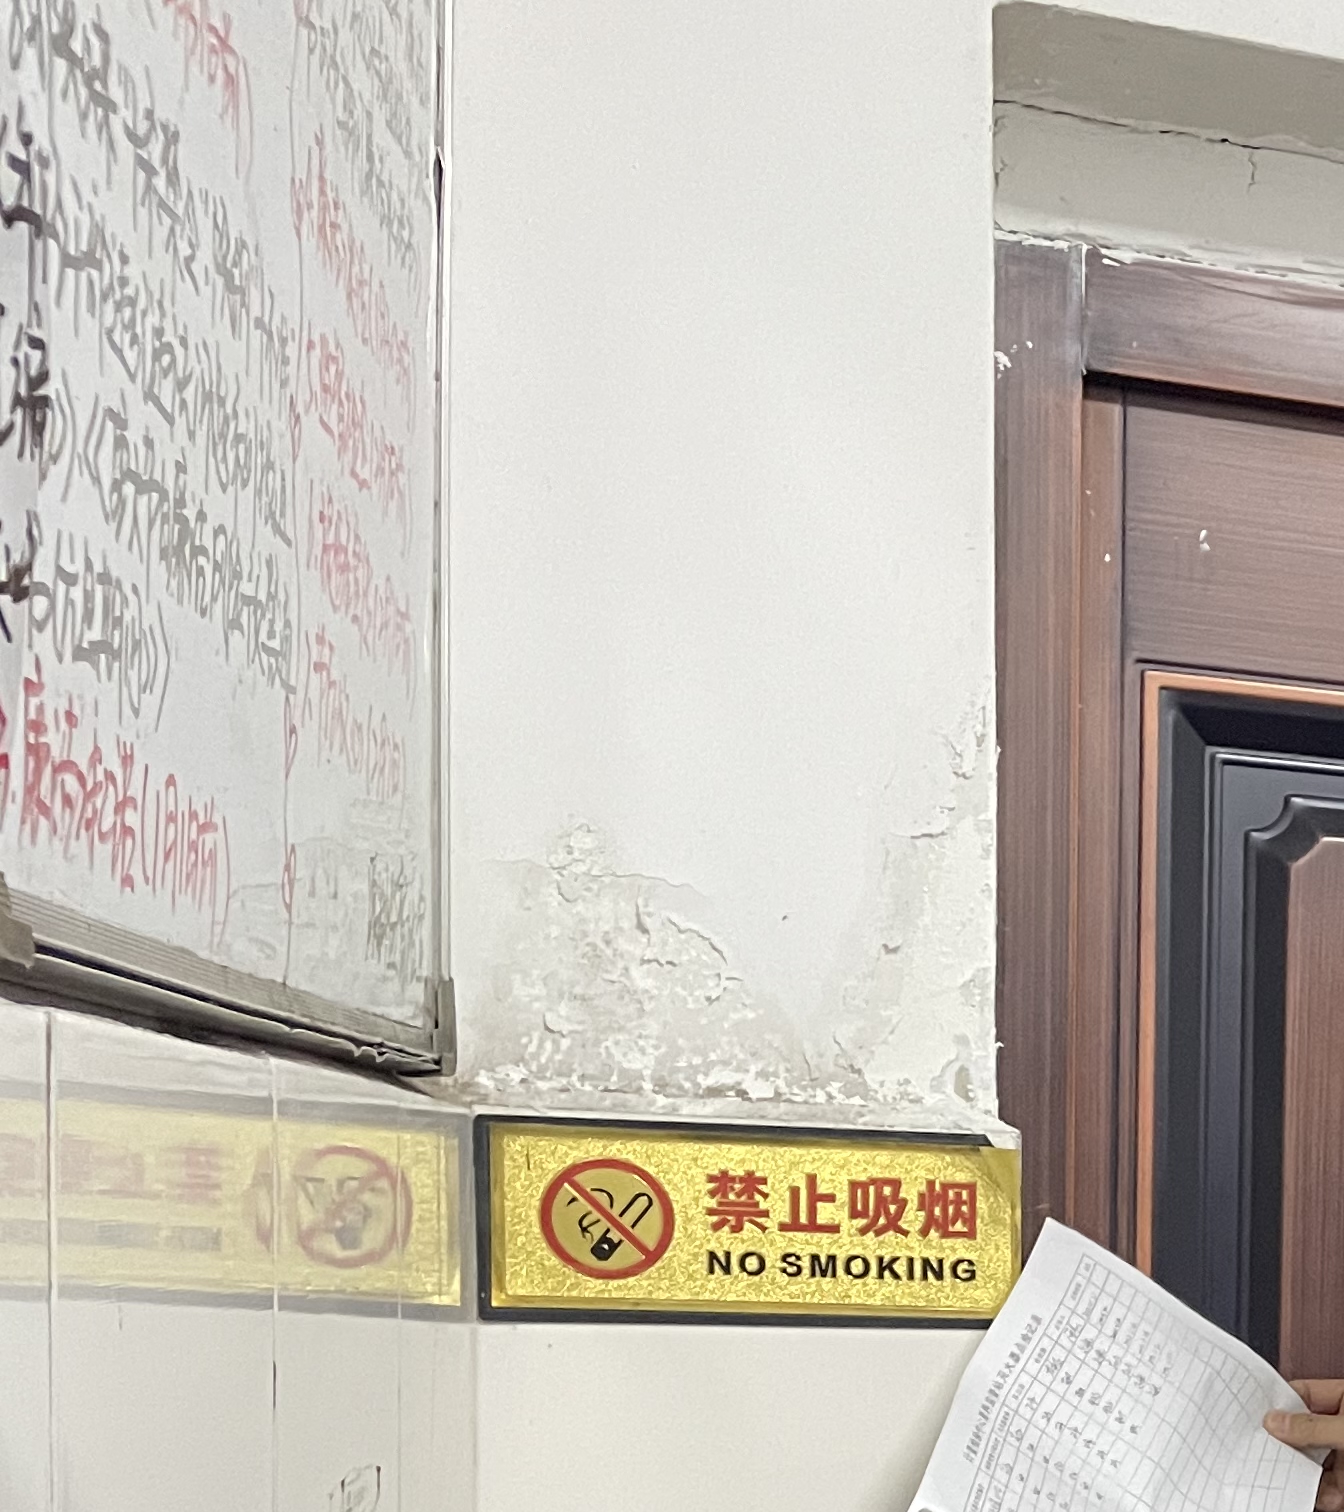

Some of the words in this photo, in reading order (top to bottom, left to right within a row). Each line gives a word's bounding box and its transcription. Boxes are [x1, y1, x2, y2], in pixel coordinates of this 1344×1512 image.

[706, 1169, 978, 1240] 禁止吸烟
[707, 1250, 766, 1277] NO
[781, 1252, 977, 1282] SMOKING
